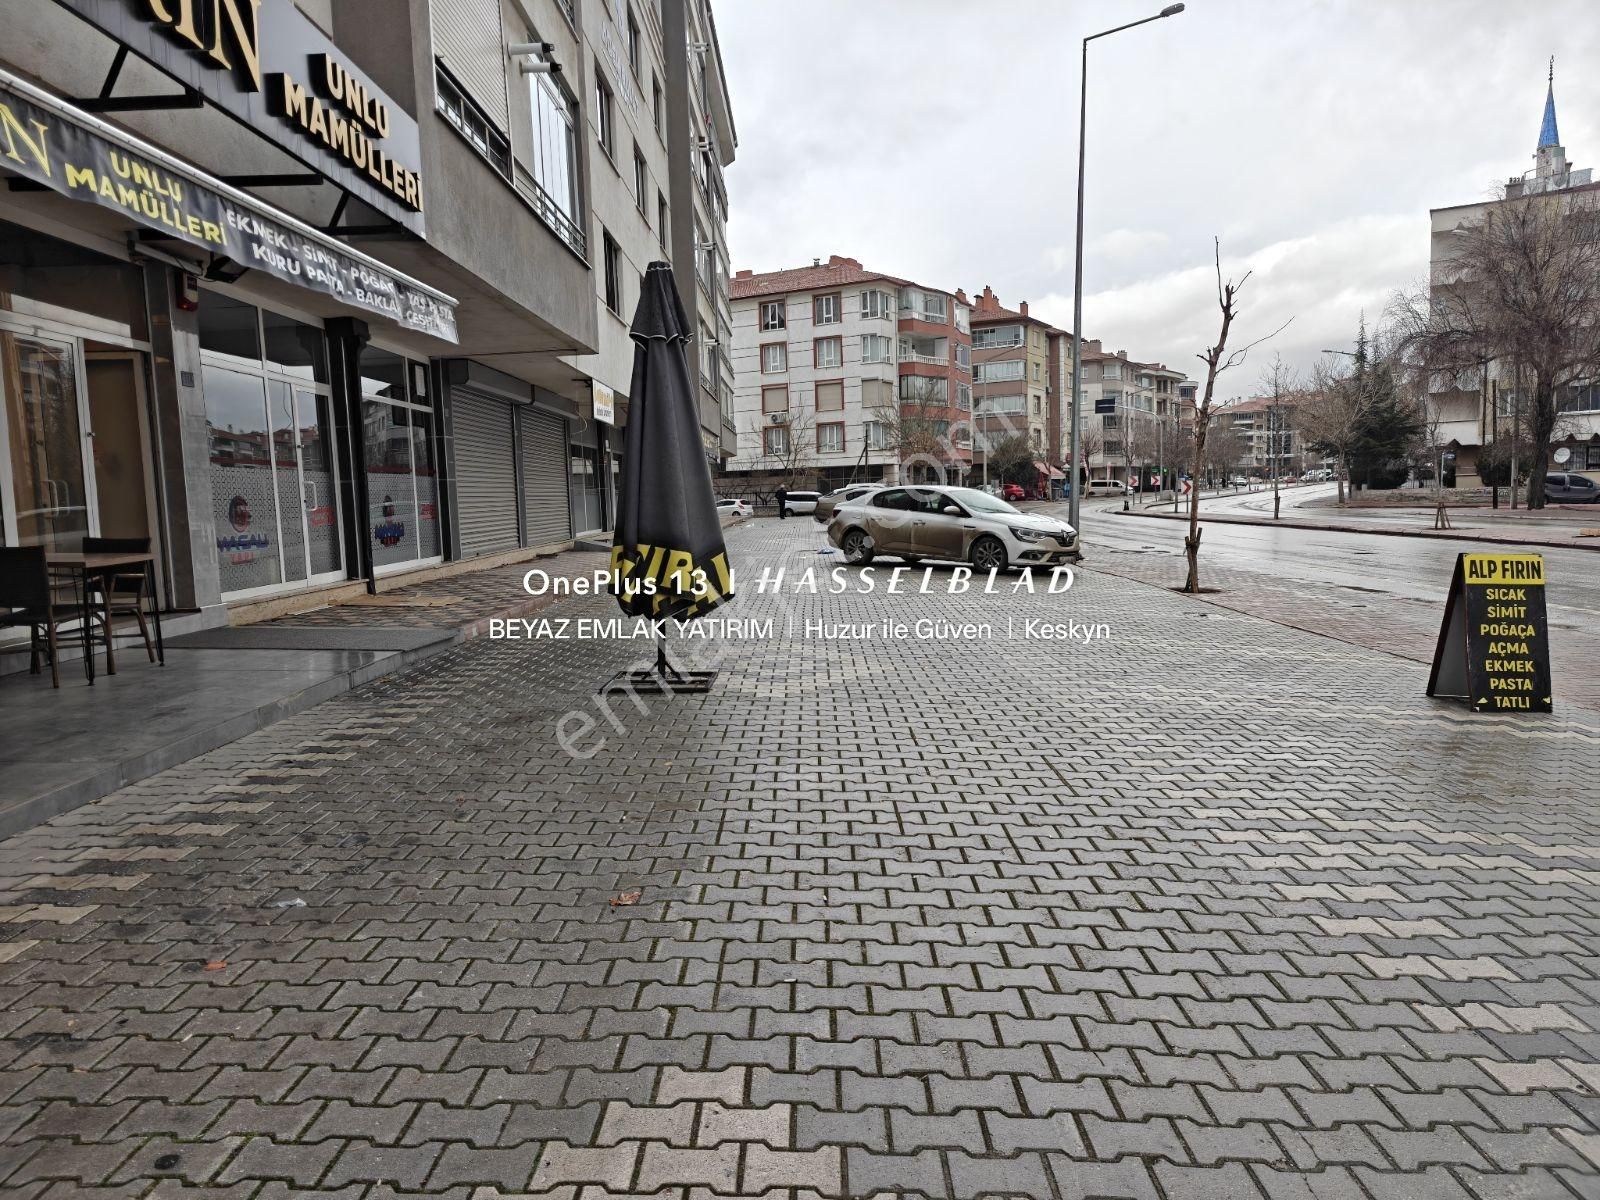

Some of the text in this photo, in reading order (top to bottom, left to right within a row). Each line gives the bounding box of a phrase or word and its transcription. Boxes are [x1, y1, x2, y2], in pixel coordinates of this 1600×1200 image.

[325, 52, 390, 139] UNLU
[283, 72, 424, 213] MAMÜLLERİ
[110, 151, 182, 203] UNLU
[64, 162, 228, 247] MAMÜLLERİ
[251, 242, 301, 275] KURU
[305, 264, 345, 295] PATA
[1468, 559, 1542, 580] ALP FIRIN
[1486, 588, 1526, 601] SICAK
[1487, 603, 1527, 618] SİMİT
[1480, 621, 1536, 640] POĞAÇA
[1488, 642, 1529, 657] AÇMA
[1485, 660, 1535, 673] EKMEK
[1489, 678, 1534, 691] PASTA
[1494, 696, 1531, 709] TATLI
